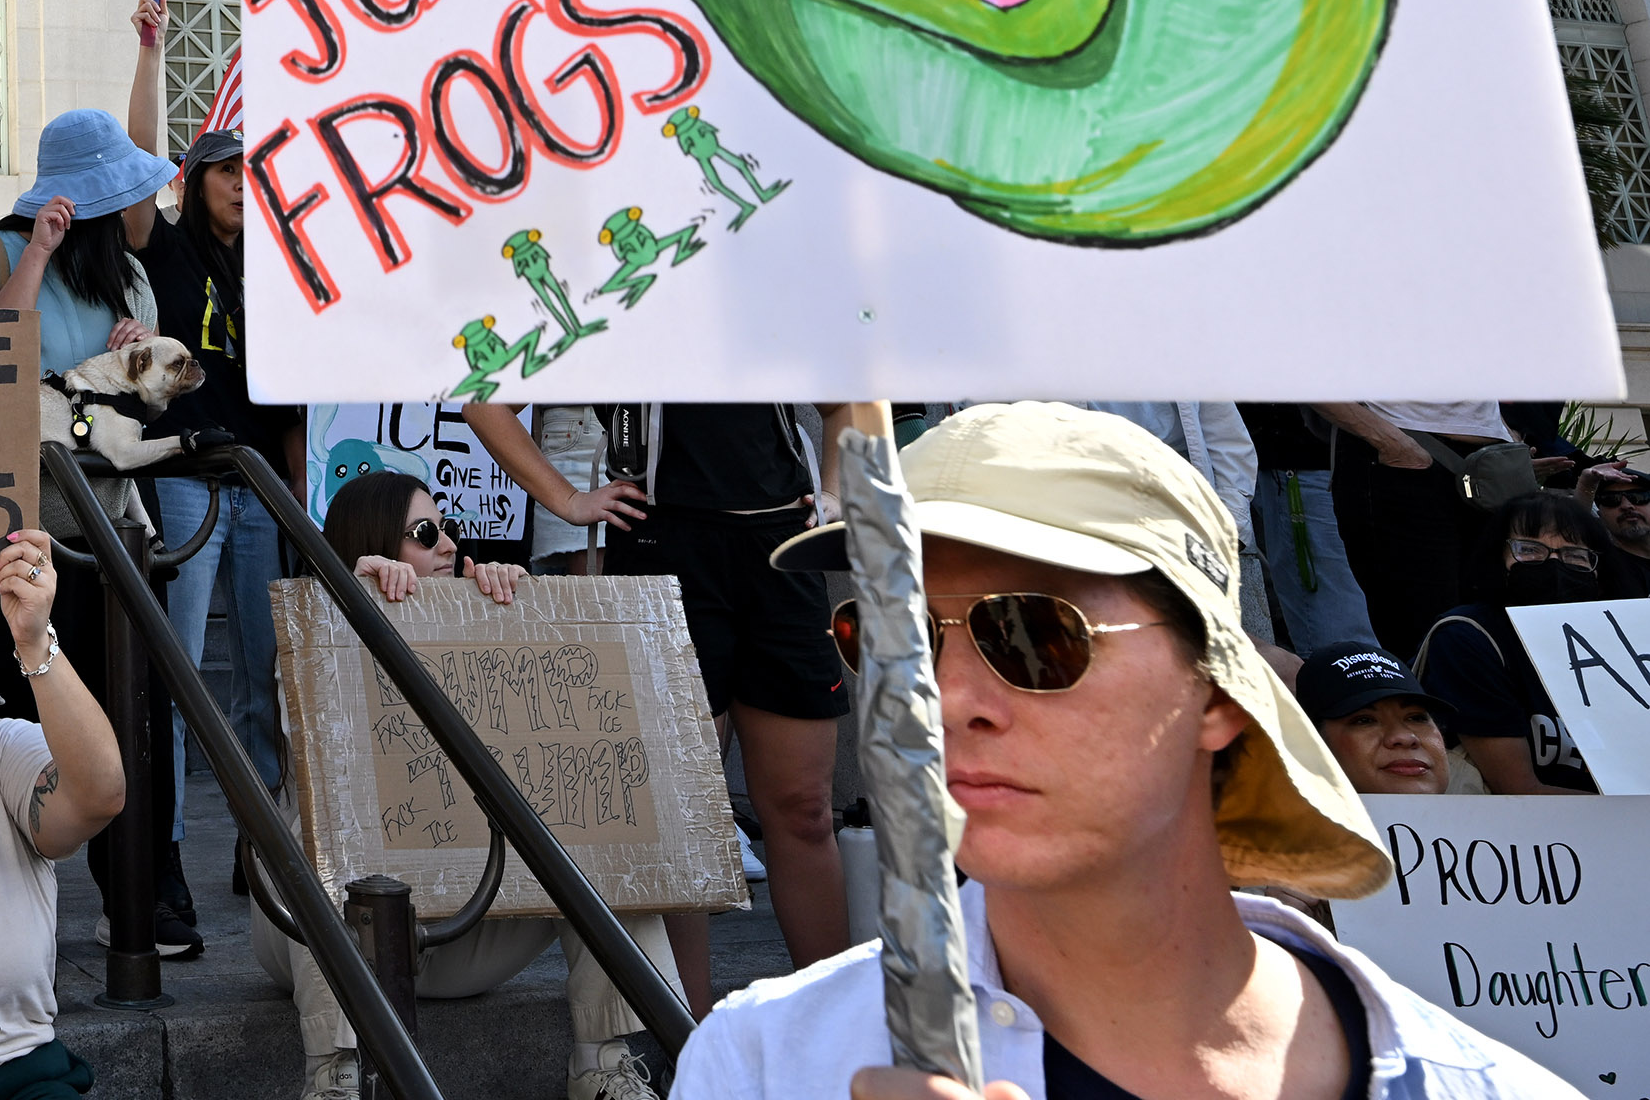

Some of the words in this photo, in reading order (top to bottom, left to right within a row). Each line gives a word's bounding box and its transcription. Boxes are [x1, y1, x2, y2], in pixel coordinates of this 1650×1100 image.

[436, 459, 482, 489] GIVE
[433, 491, 466, 515] CK
[479, 493, 512, 521] HIS
[459, 513, 515, 539] ANIE!
[1331, 652, 1400, 671] Disneyland
[598, 715, 623, 734] ICE
[406, 736, 650, 830] TUMP
[422, 819, 458, 848] ICE
[1387, 823, 1581, 905] PROUD
[1443, 942, 1650, 1039] Daughter
